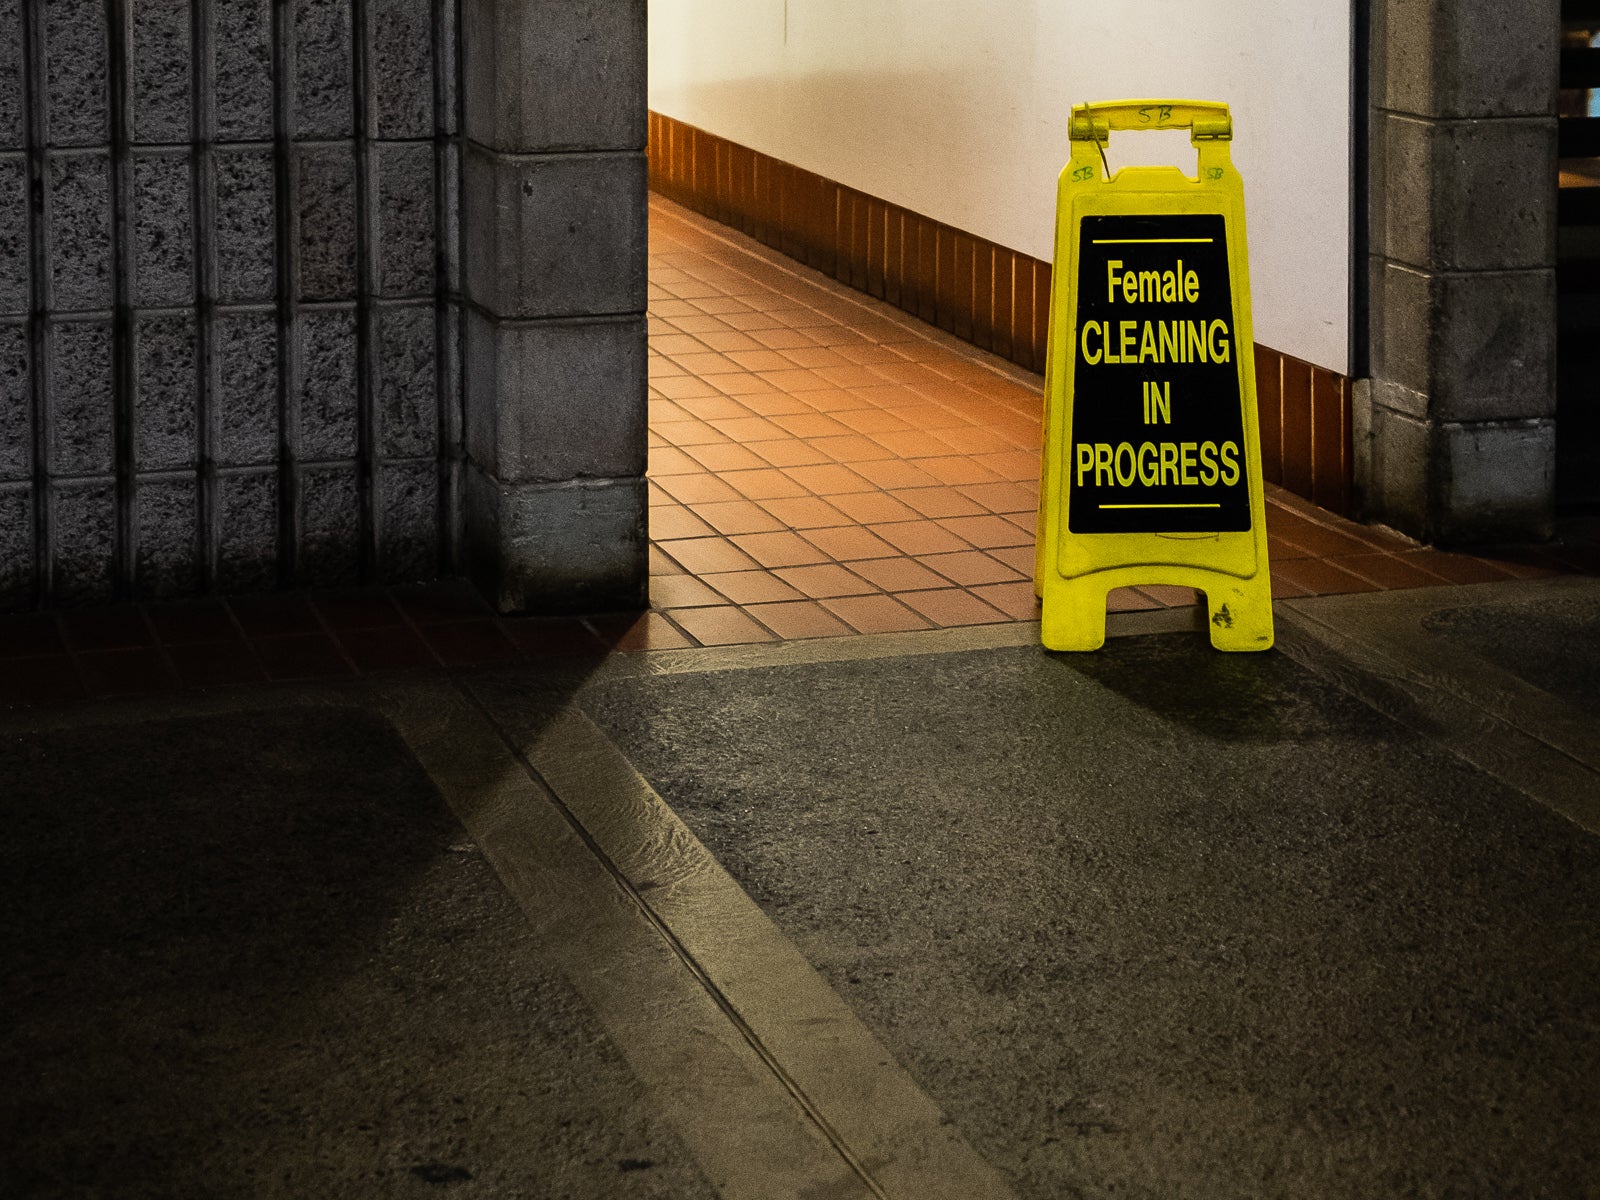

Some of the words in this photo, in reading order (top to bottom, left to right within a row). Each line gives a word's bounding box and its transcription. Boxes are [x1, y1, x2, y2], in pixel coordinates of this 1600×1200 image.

[1107, 259, 1200, 304] Female
[1081, 318, 1230, 366] CLEANING
[1143, 381, 1171, 425] IN
[1076, 440, 1240, 488] PROGRESS
